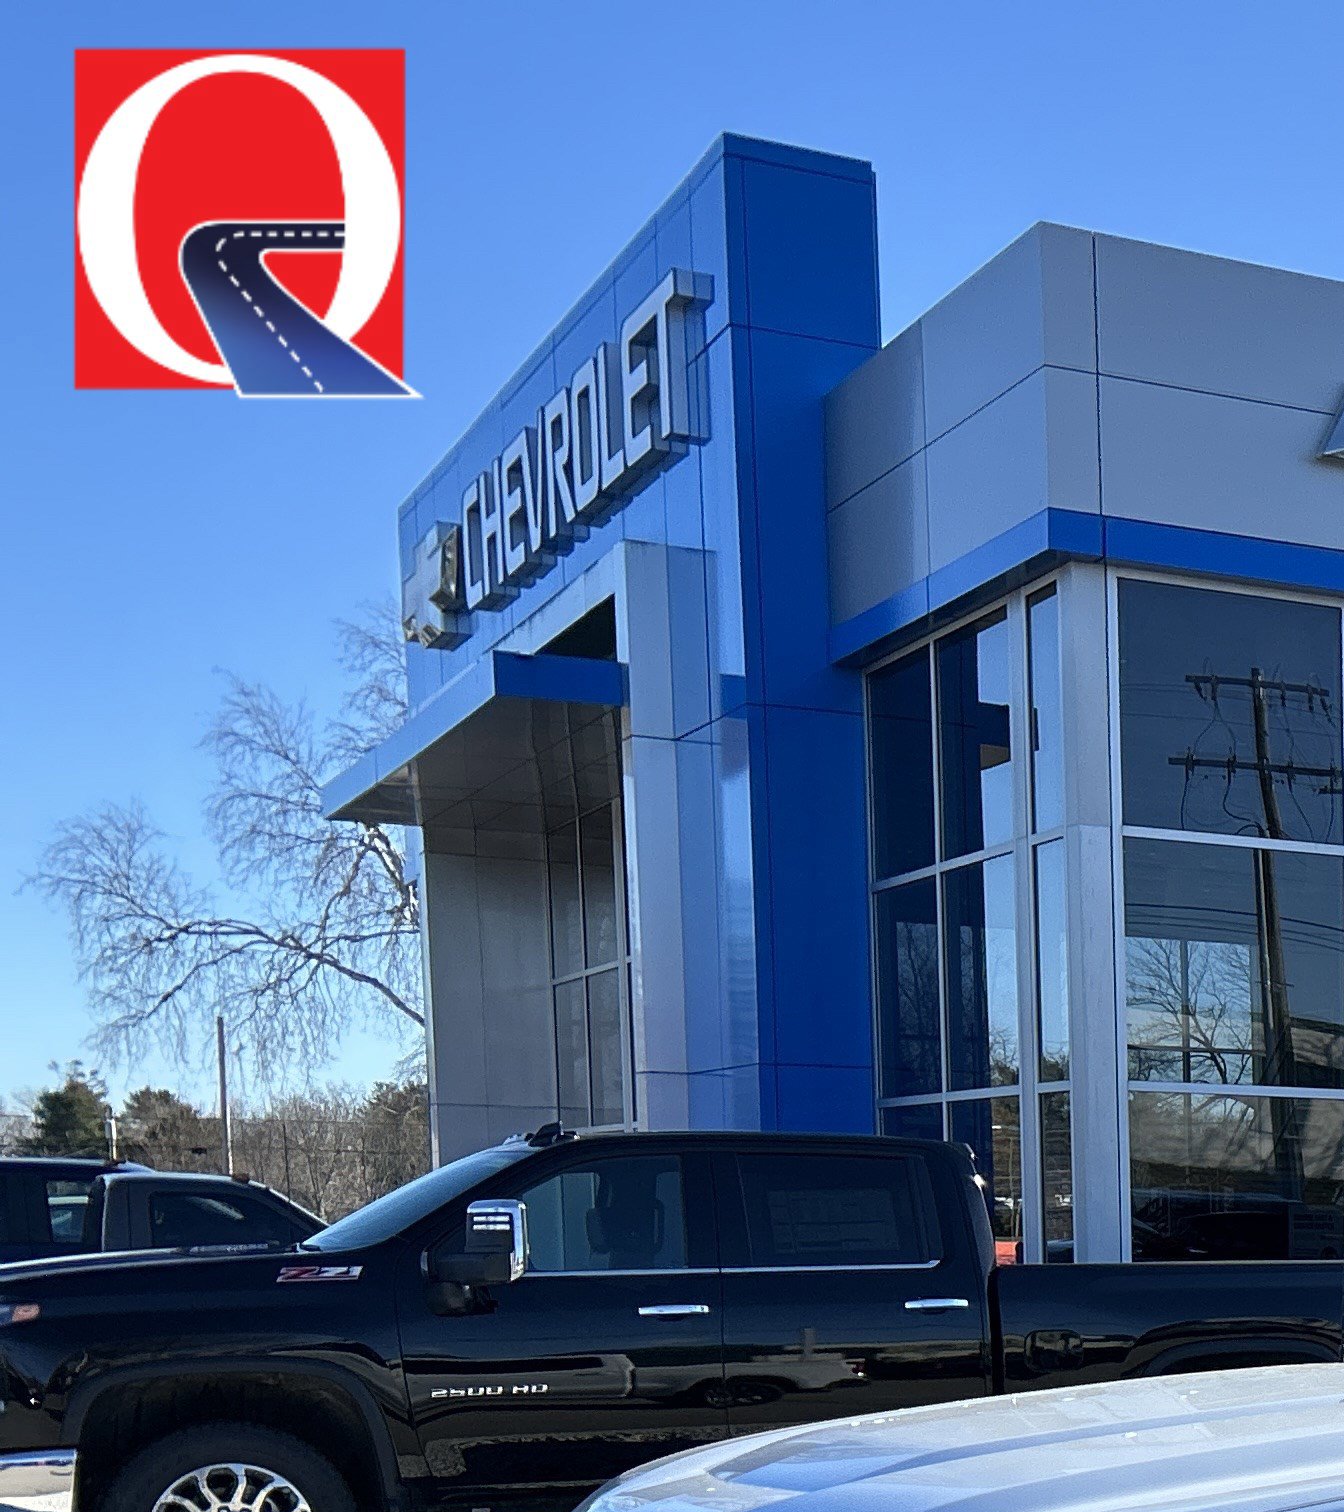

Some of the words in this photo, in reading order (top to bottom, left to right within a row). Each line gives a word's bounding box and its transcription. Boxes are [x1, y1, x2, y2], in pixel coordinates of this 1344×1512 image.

[461, 267, 708, 611] CHEVROLET
[276, 1265, 364, 1283] Z71
[430, 1386, 504, 1398] 2500
[511, 1383, 549, 1395] HD
